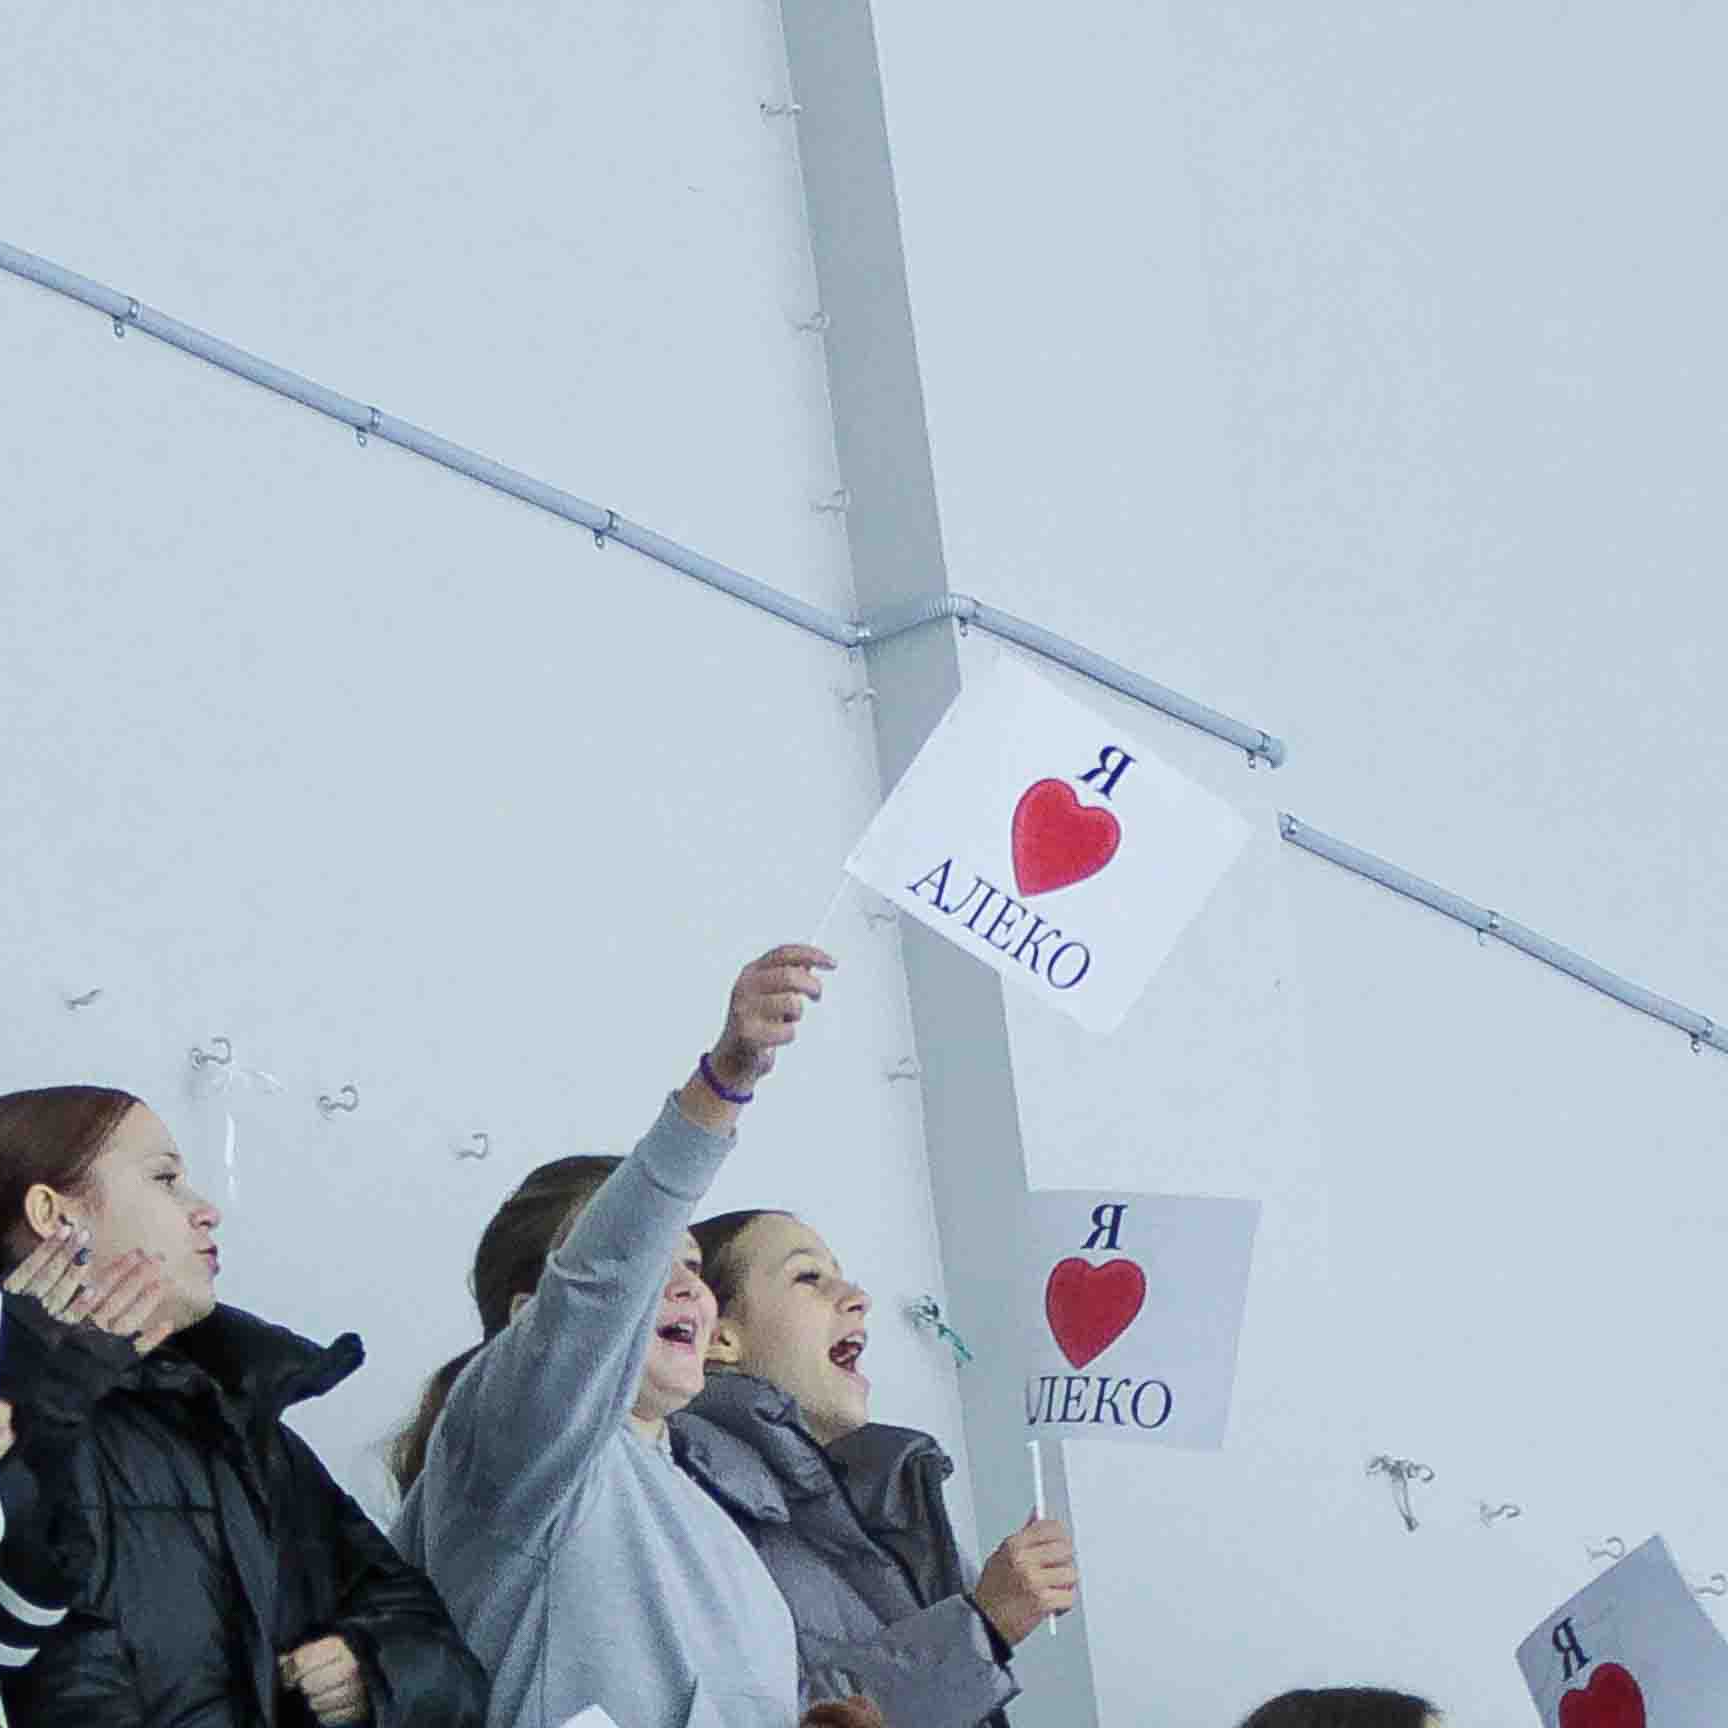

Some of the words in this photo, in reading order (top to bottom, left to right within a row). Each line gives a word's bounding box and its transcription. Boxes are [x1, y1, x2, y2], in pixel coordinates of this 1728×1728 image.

[1076, 744, 1138, 801] Я
[907, 857, 1093, 992] АЛЕКО
[1080, 1203, 1129, 1250] Я
[1552, 1617, 1592, 1682] Я
